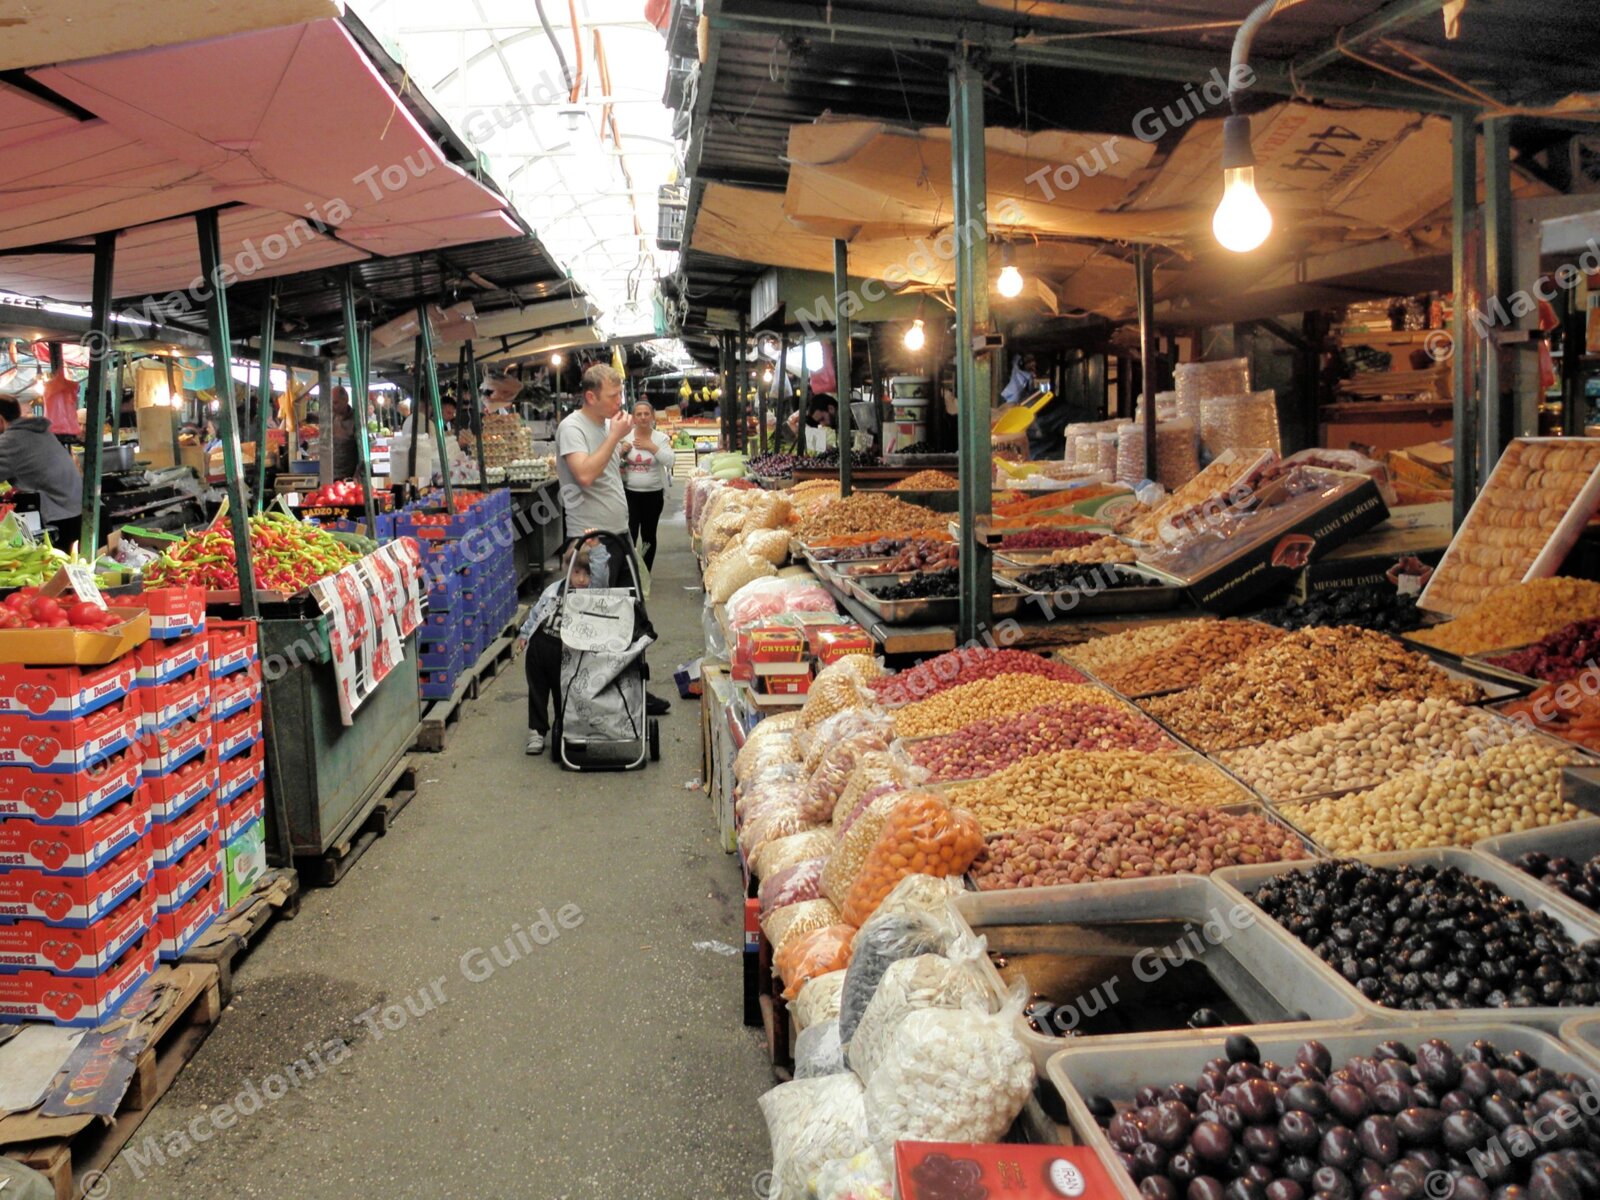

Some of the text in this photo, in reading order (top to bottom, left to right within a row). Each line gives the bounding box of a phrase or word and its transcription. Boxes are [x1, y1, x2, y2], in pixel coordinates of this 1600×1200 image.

[1314, 497, 1379, 539] MEDJOUL DATES
[174, 651, 193, 667] Domati
[760, 644, 801, 653] CRYSTAL
[832, 647, 873, 655] CRYSTAL
[94, 679, 117, 698] Domati
[176, 696, 194, 712] Domati
[98, 729, 122, 750] Domati
[179, 737, 197, 755] Domati
[100, 777, 123, 799] Domati
[184, 780, 203, 800] Domati
[107, 825, 130, 848] Domati
[184, 823, 202, 843] Domati
[111, 874, 134, 898] Domati
[189, 866, 206, 887] Domati
[192, 908, 209, 931] Domati
[119, 921, 140, 944] Domati
[119, 967, 141, 992] Domati
